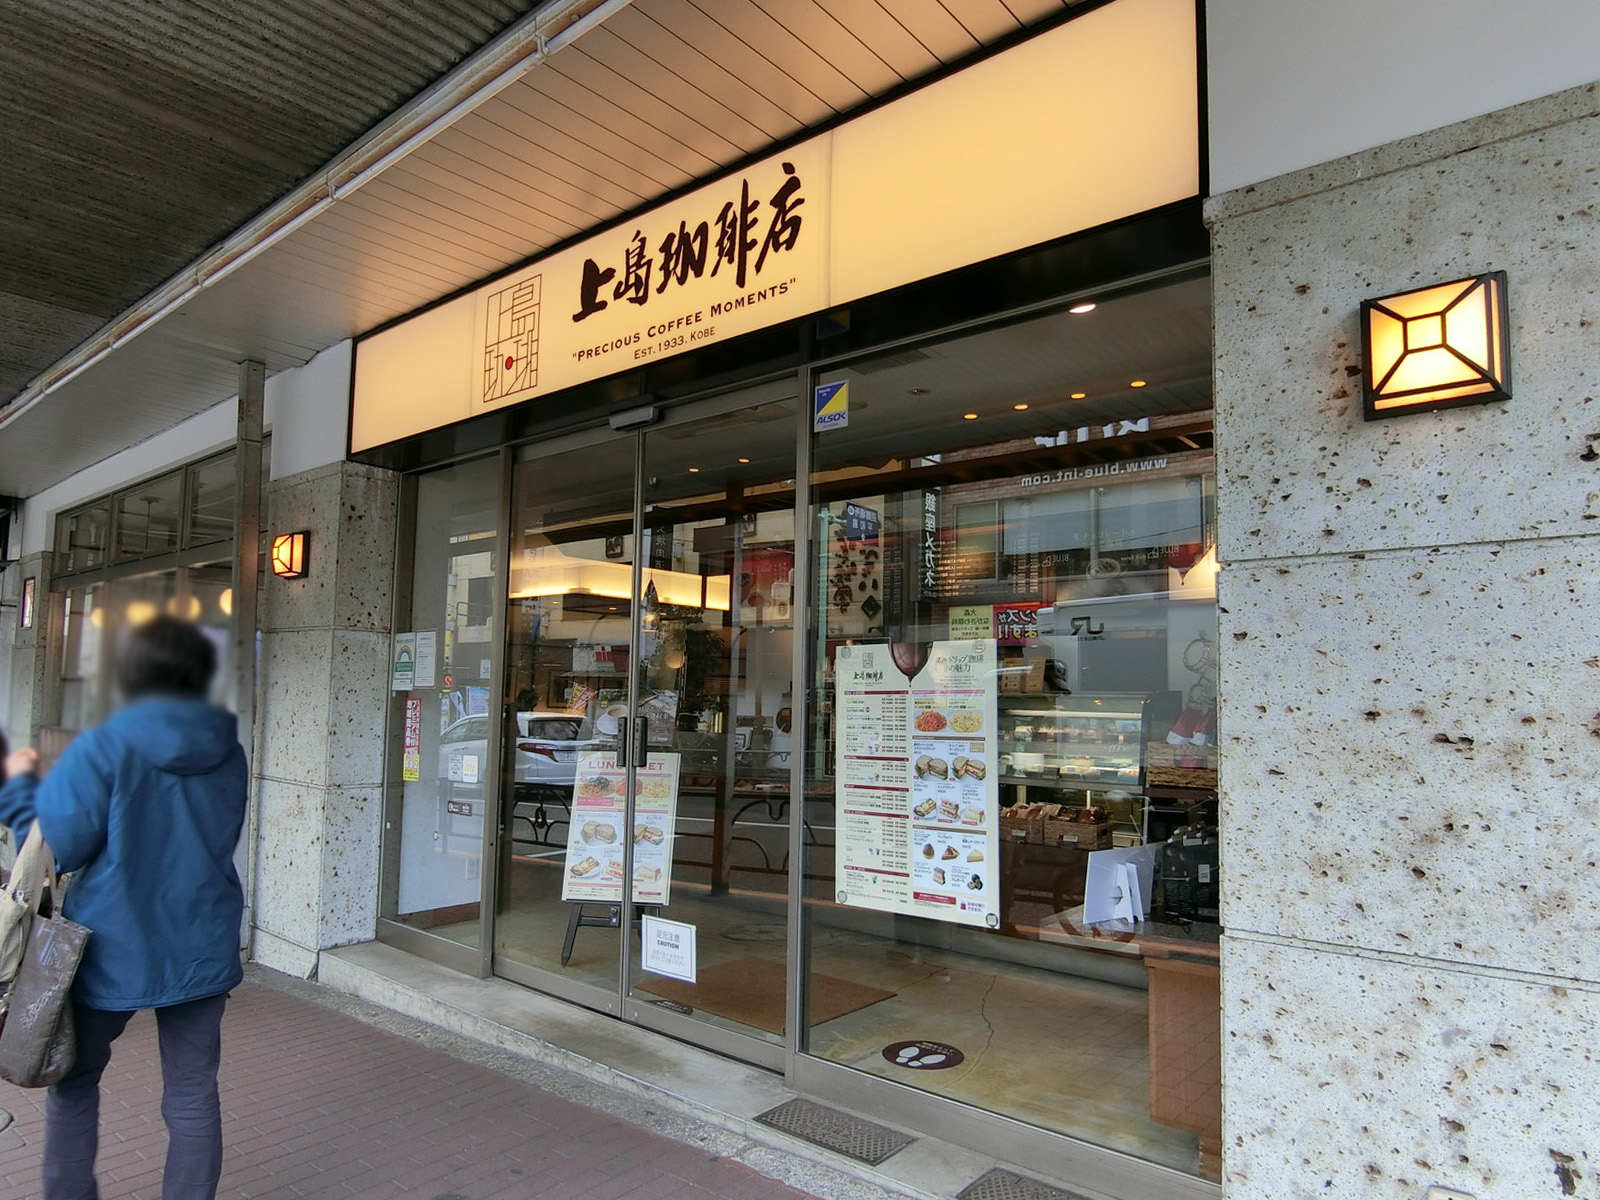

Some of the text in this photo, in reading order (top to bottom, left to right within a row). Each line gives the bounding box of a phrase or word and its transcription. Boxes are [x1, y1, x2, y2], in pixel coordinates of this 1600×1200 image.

[572, 161, 806, 323] 上島珈琲店
[647, 311, 703, 339] COFFEE
[690, 326, 716, 342] KOBE
[816, 411, 846, 425] ALSOK
[949, 663, 971, 672] の魅力
[656, 929, 681, 943] 足元注意
[657, 939, 680, 949] CAUTION
